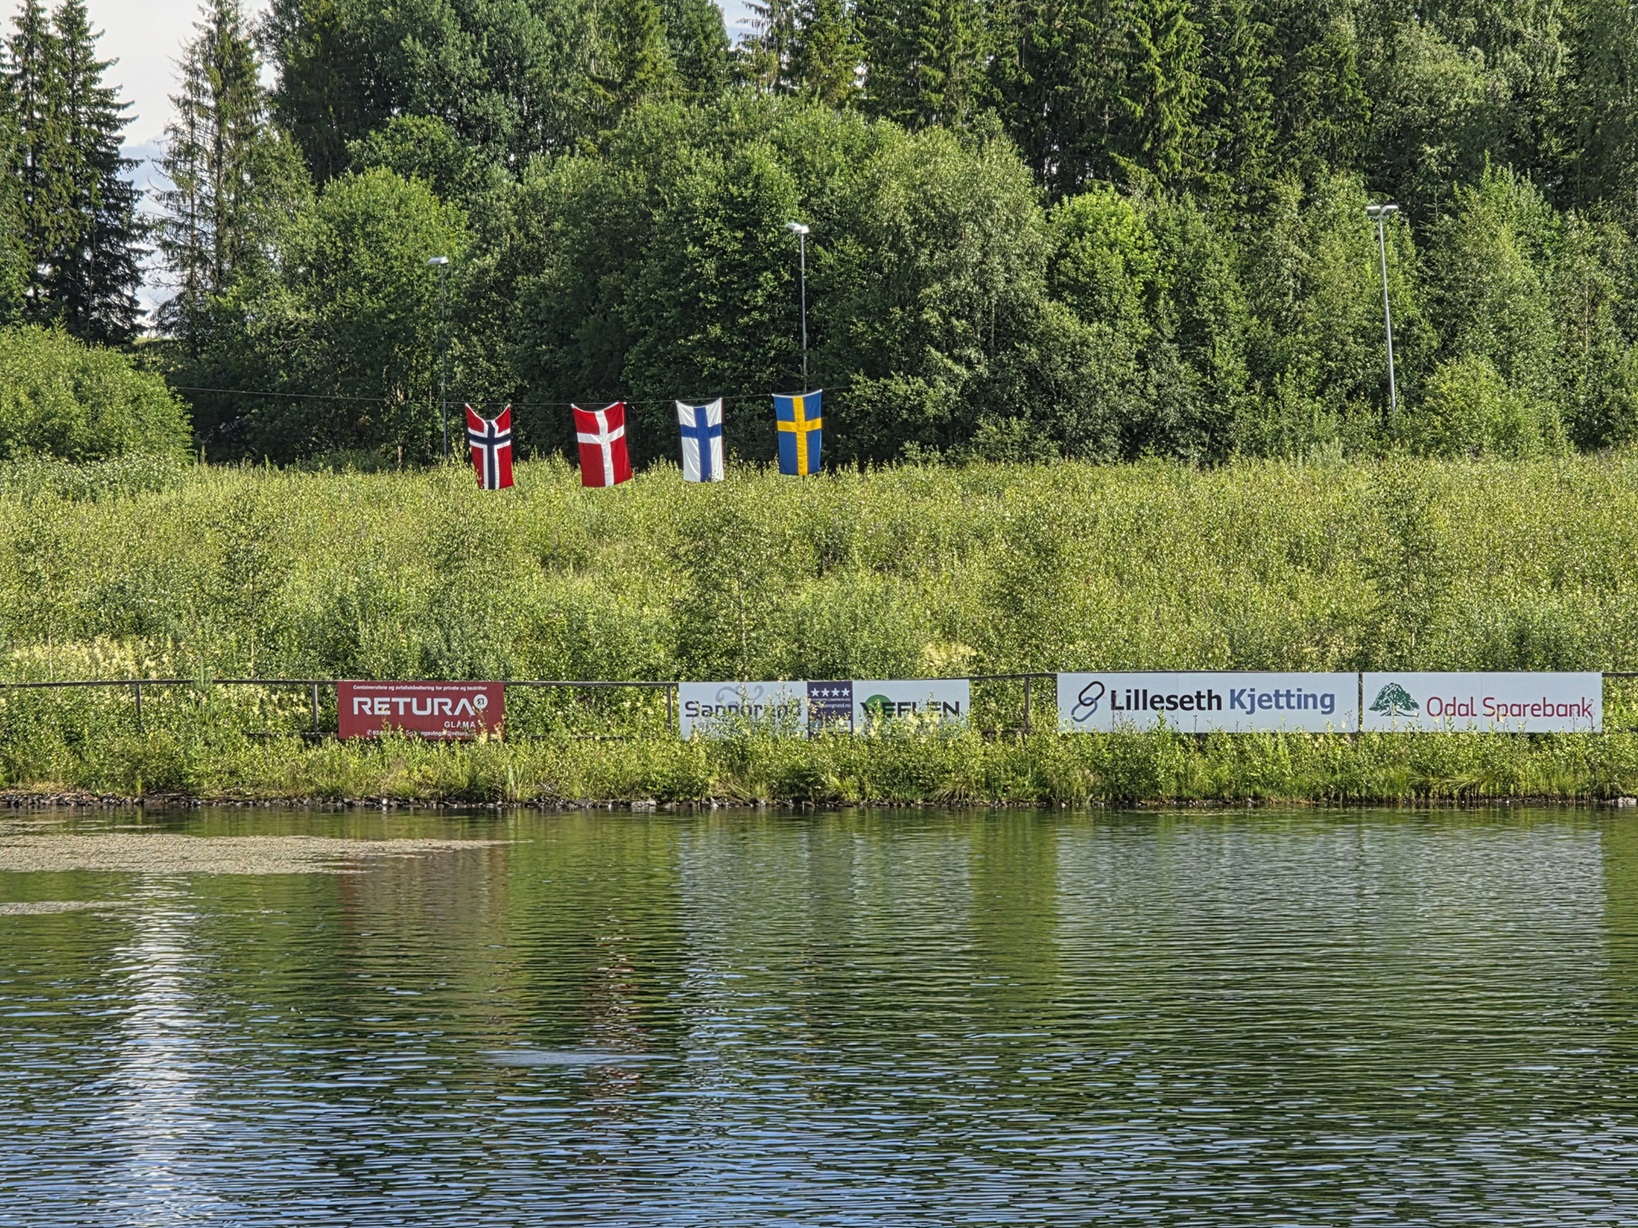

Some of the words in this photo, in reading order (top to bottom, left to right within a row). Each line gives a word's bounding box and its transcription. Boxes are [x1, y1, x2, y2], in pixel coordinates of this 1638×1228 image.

[353, 697, 476, 716] RETURA
[1110, 689, 1223, 711] Lilleseth
[1229, 688, 1336, 714] Kjetting
[1427, 696, 1478, 717] Odal
[1482, 696, 1594, 722] Sparebank
